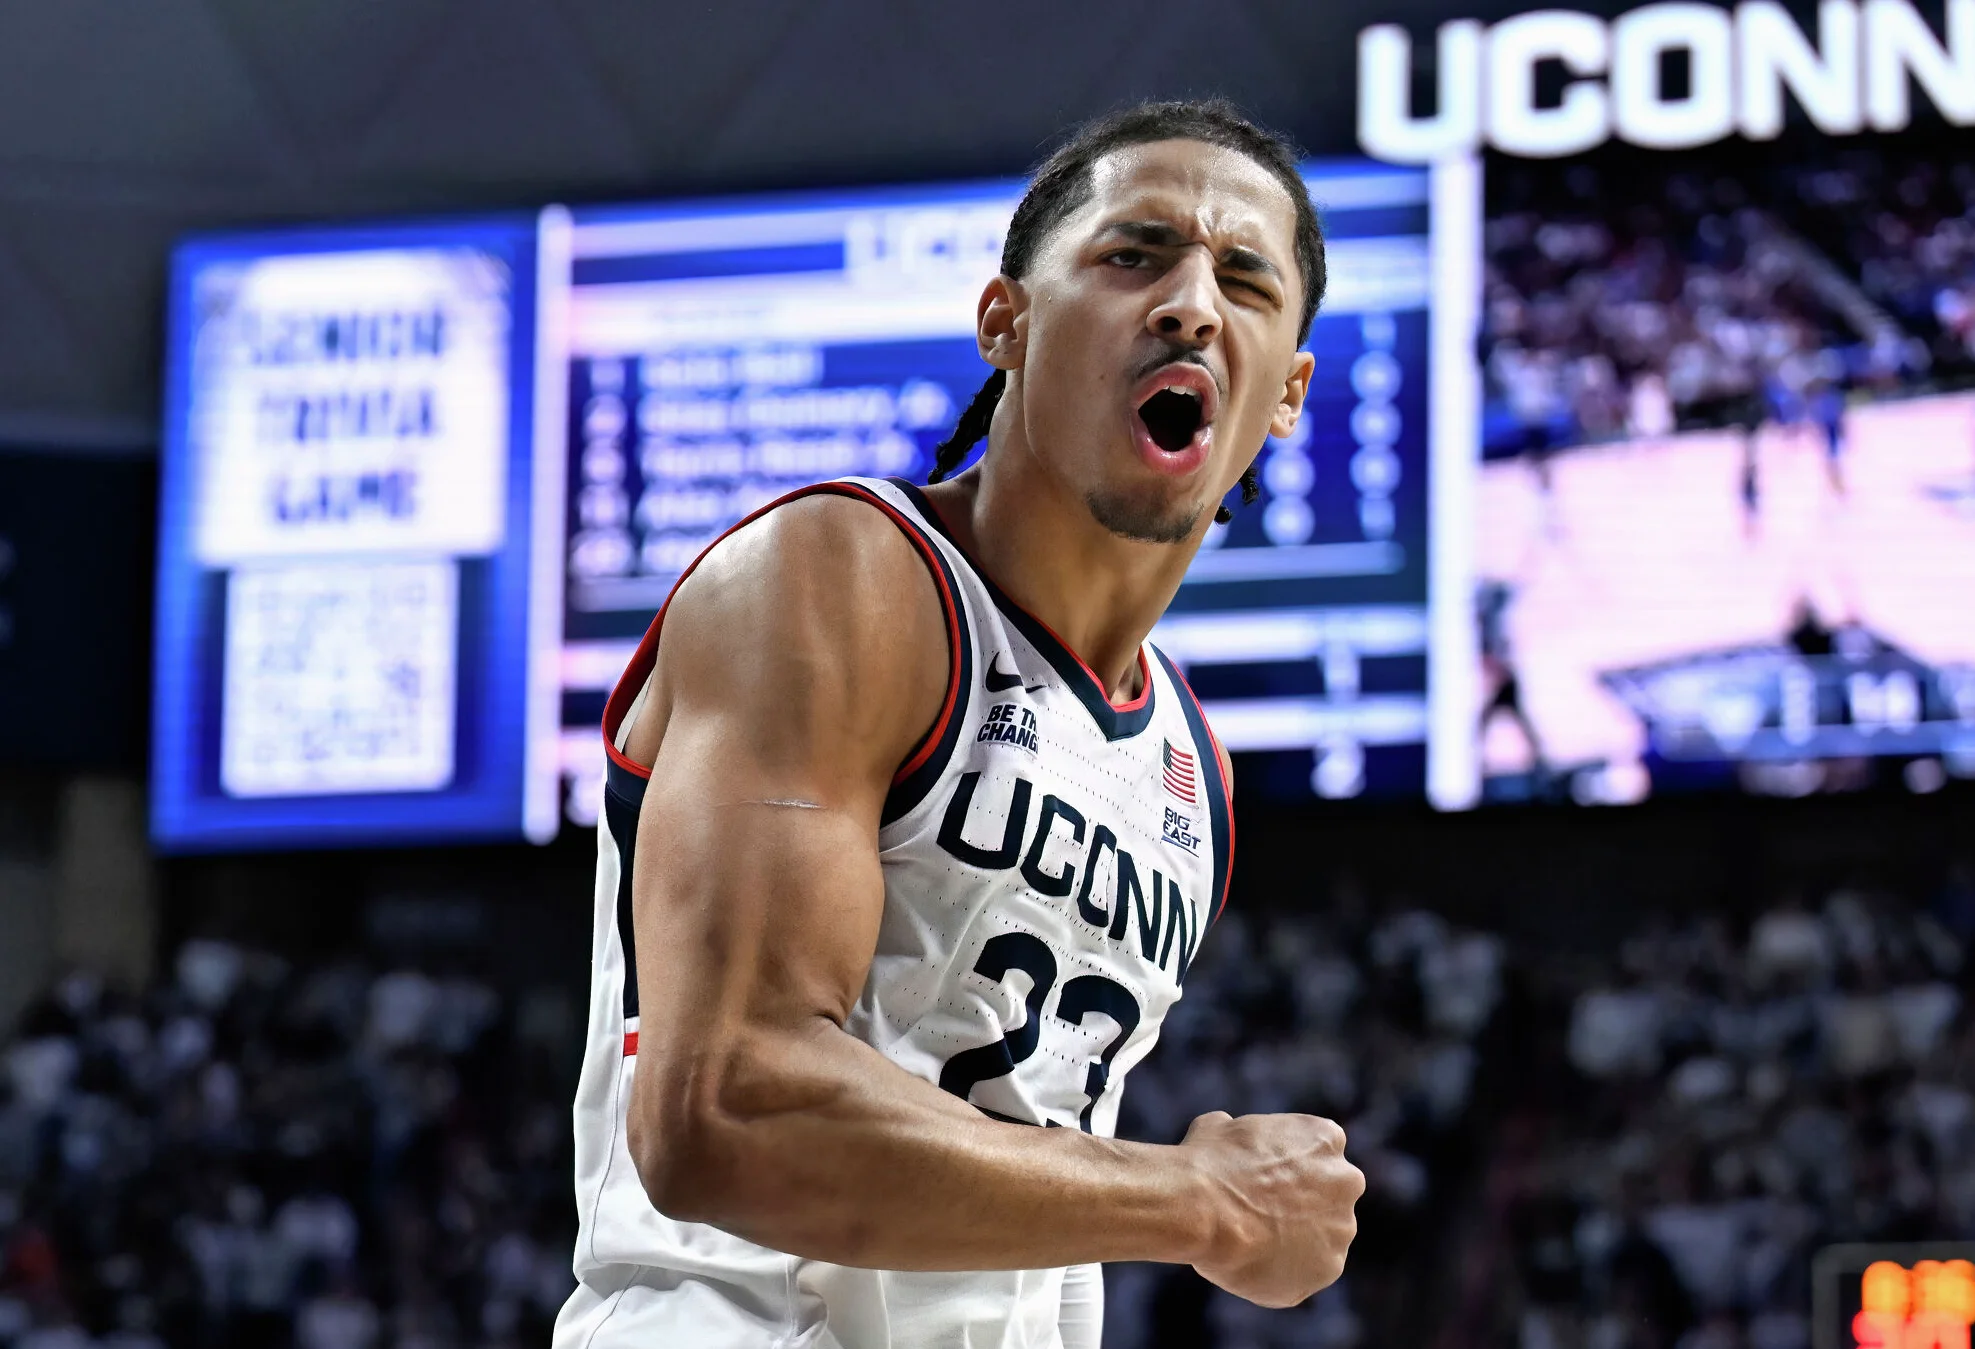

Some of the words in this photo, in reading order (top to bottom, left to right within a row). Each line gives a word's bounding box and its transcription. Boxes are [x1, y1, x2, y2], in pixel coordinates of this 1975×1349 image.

[1357, 0, 1974, 163] UCONN
[987, 704, 1017, 722] BE
[1021, 707, 1038, 734] TH
[977, 722, 1039, 755] CHANG
[1162, 819, 1201, 850] EAST
[1164, 806, 1191, 831] BIG
[936, 771, 1198, 988] UCONN
[938, 931, 1141, 1136] 23
